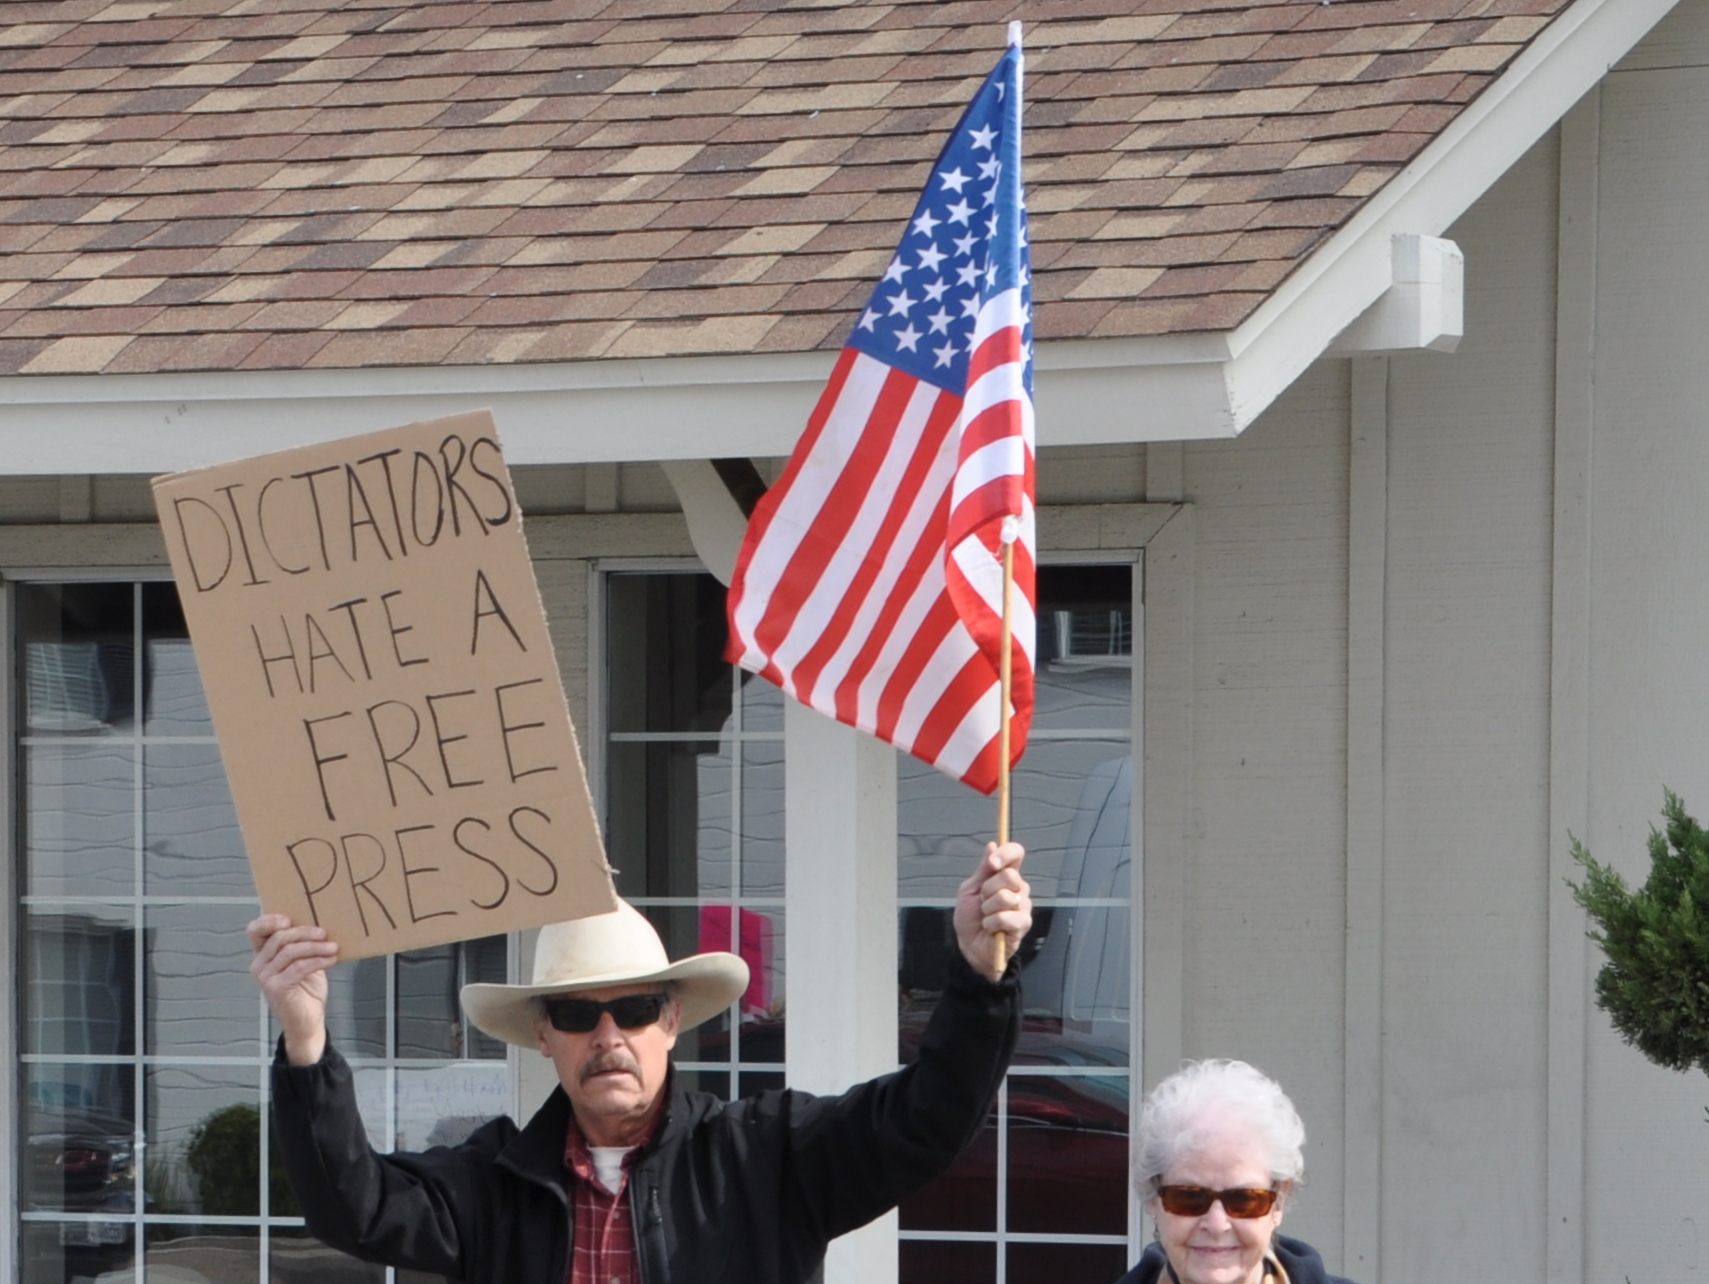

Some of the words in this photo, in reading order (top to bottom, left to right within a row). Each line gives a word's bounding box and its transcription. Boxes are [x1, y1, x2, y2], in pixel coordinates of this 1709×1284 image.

[173, 434, 512, 593] DICTATORS
[250, 590, 430, 698] HATE
[470, 568, 528, 656] A
[303, 678, 559, 822] FREE
[286, 806, 559, 938] PRESS
